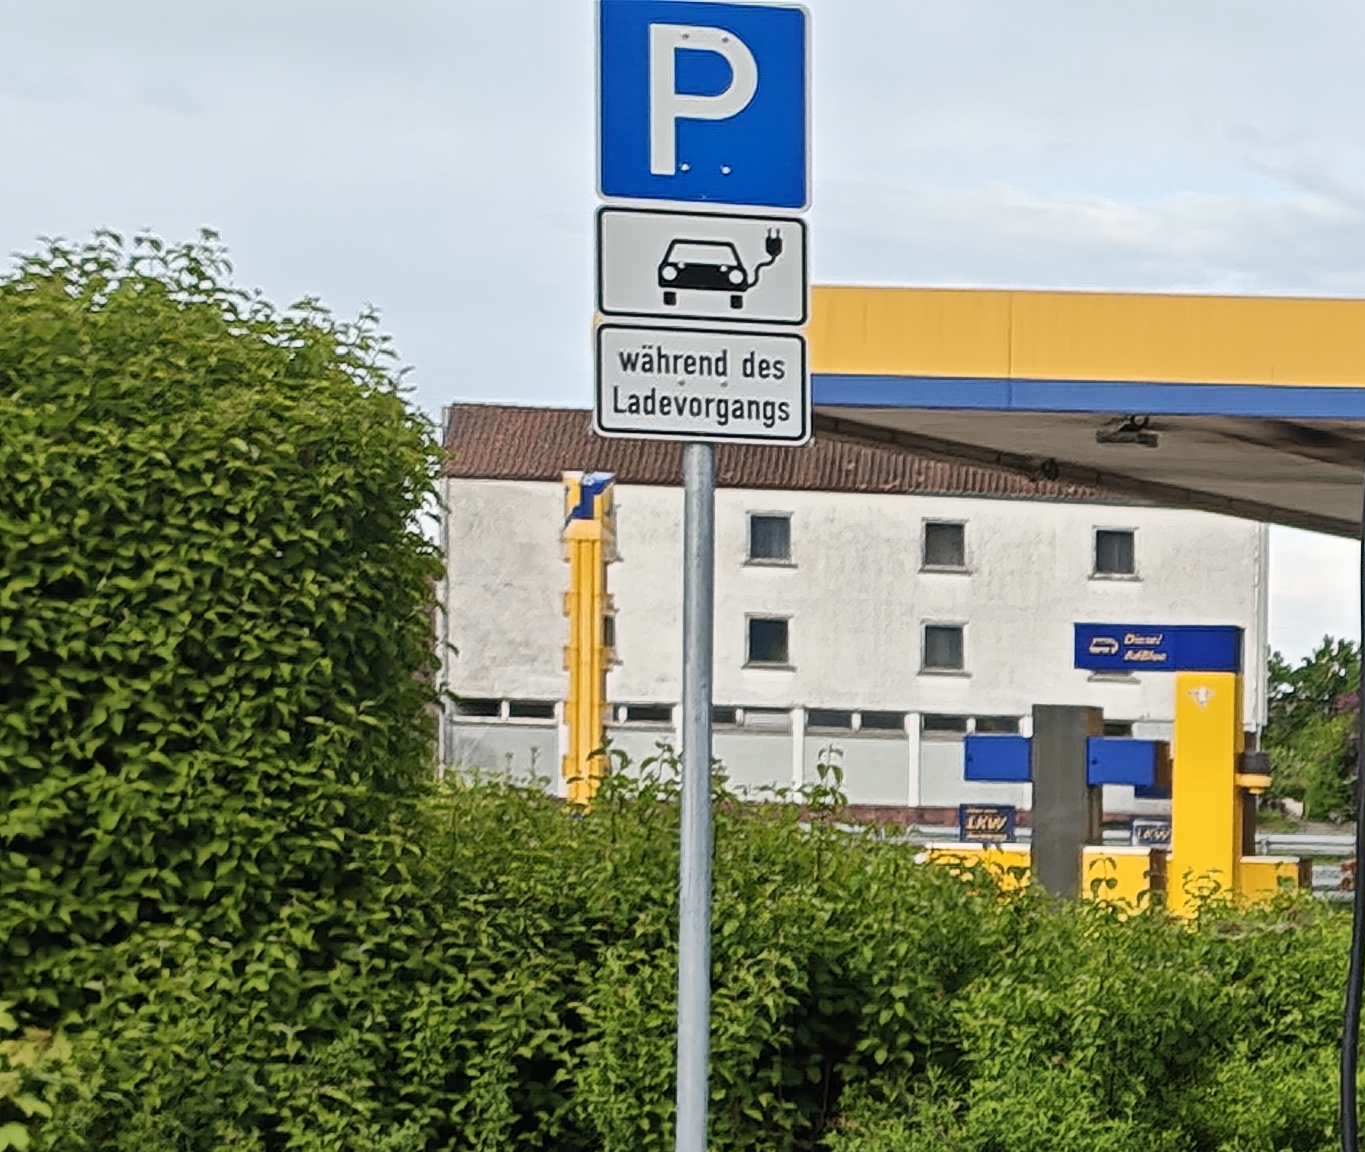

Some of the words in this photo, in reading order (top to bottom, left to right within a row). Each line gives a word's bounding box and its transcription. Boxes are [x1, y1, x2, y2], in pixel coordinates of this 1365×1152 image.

[648, 22, 759, 176] P
[618, 344, 729, 378] während
[741, 351, 786, 380] des
[612, 385, 791, 428] Ladevorgangs
[1123, 633, 1163, 646] Diesel
[965, 815, 1008, 830] LKW
